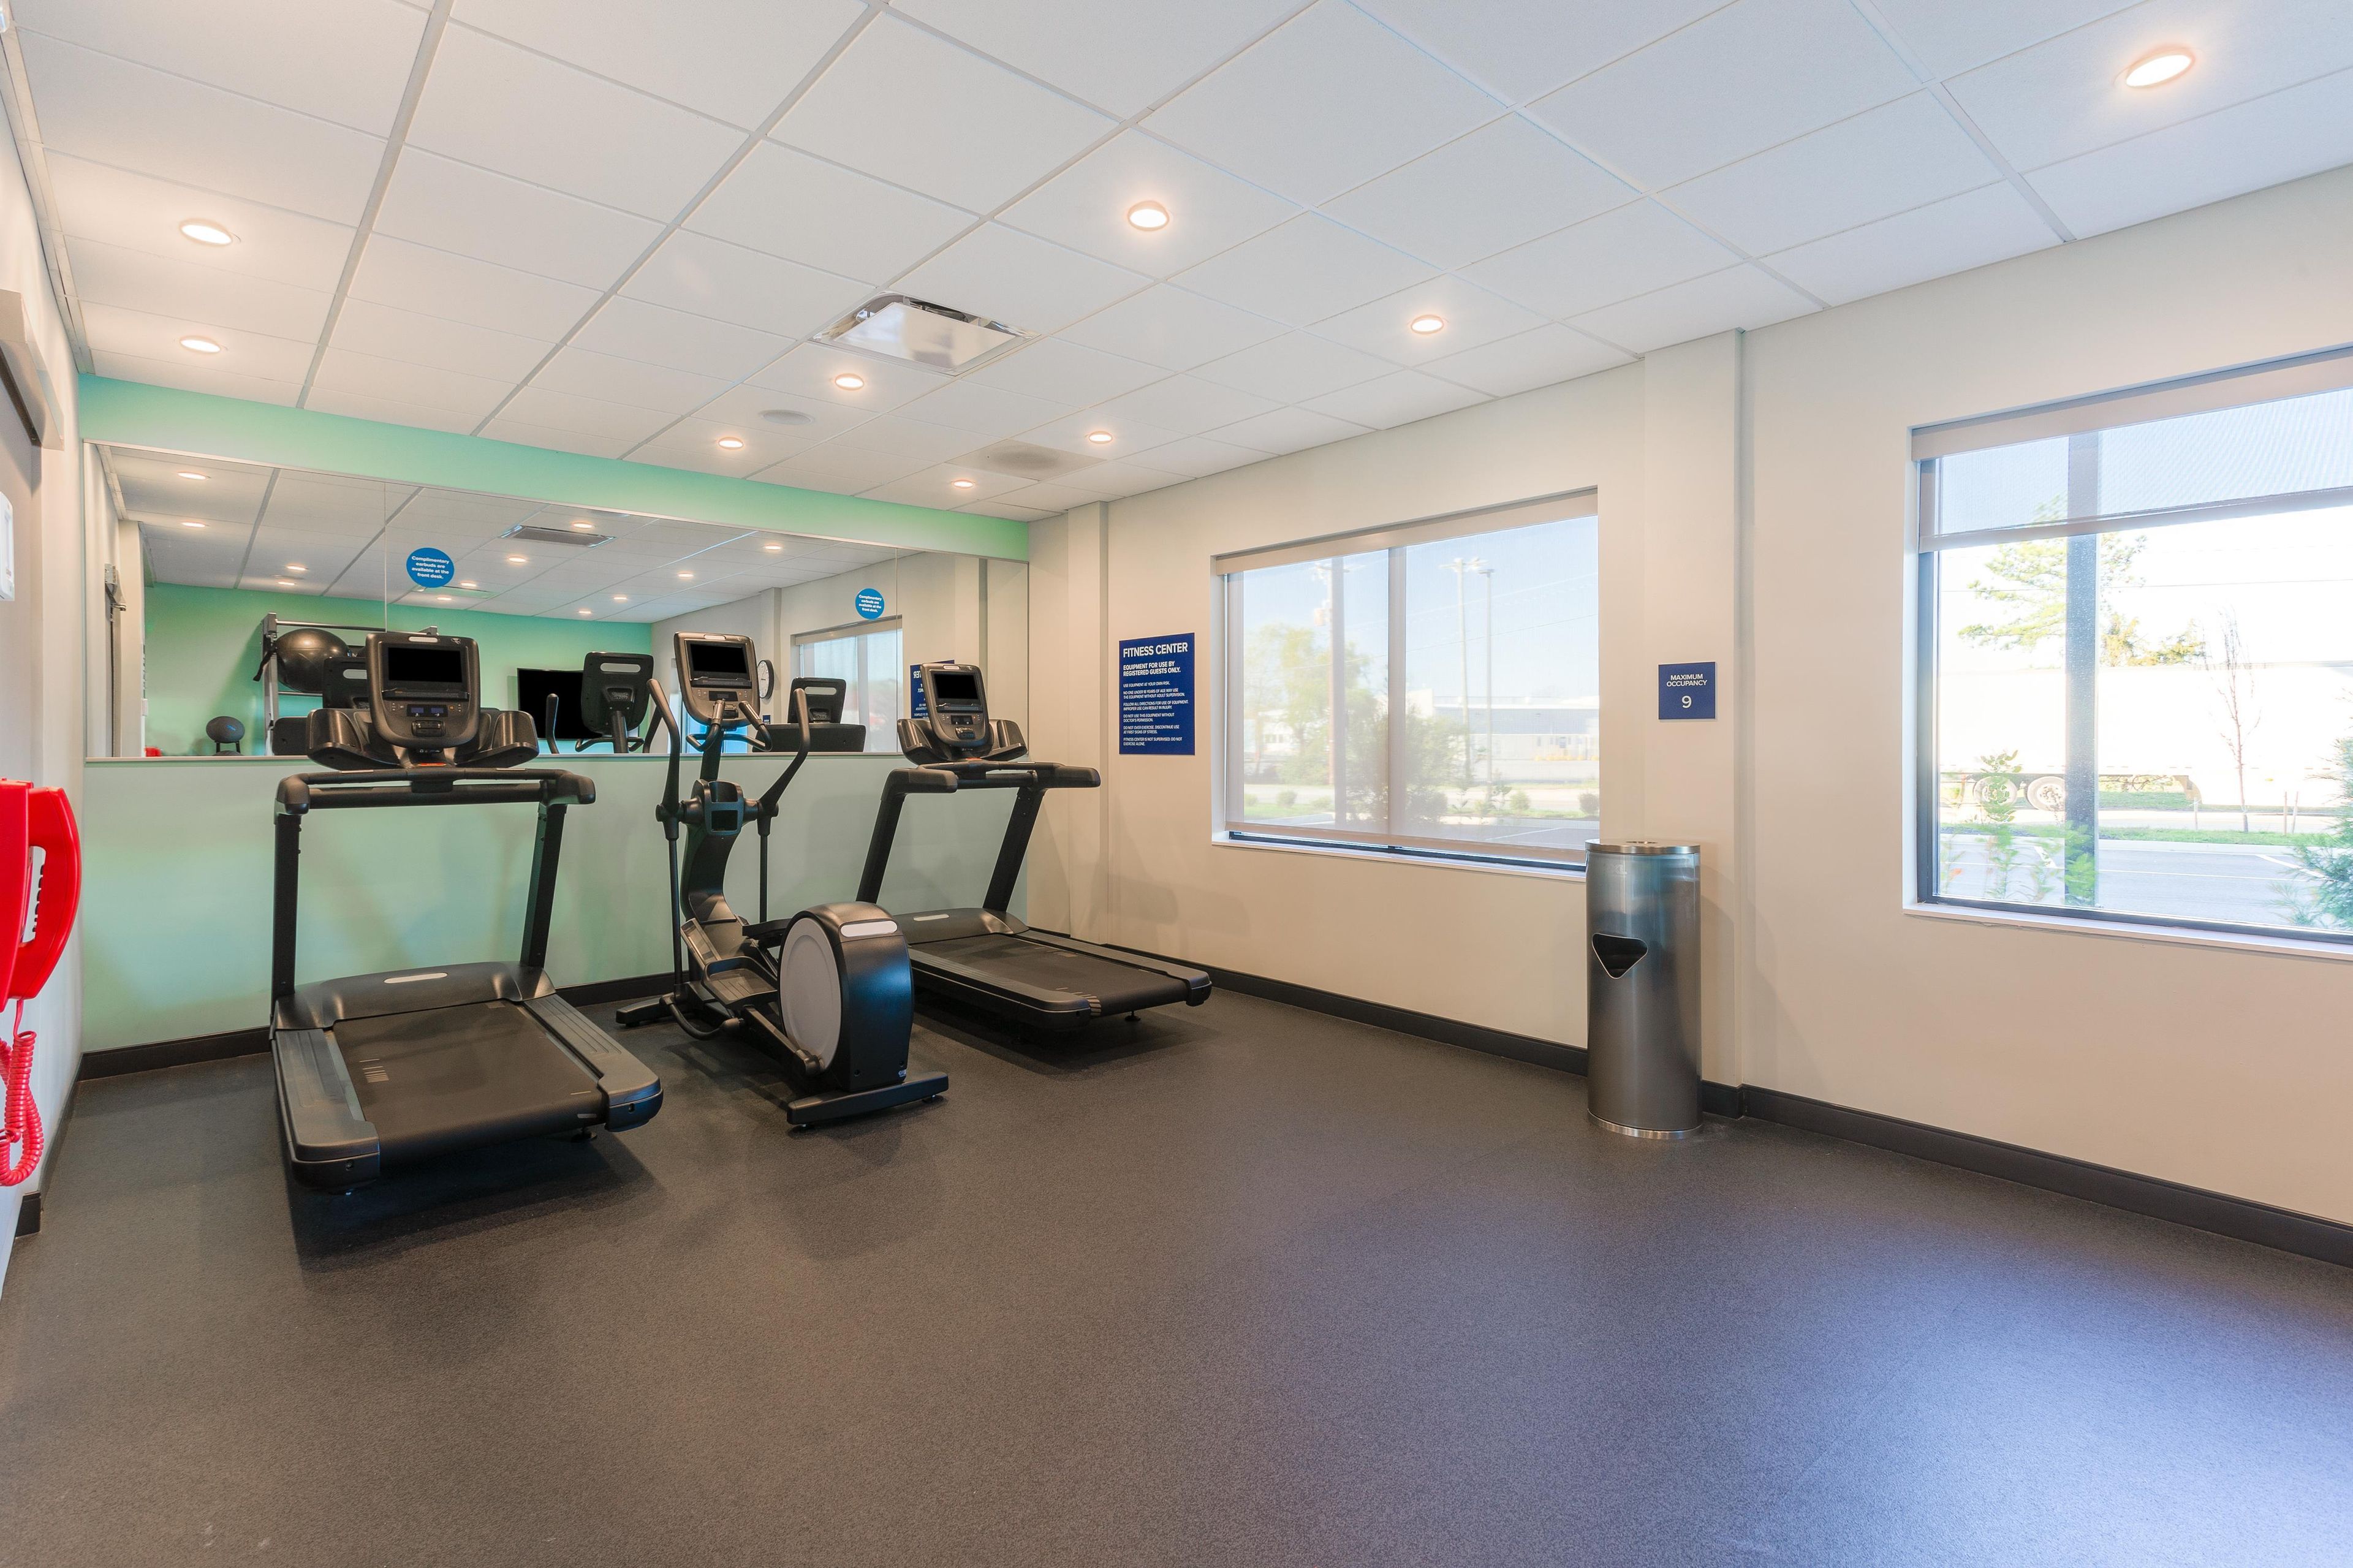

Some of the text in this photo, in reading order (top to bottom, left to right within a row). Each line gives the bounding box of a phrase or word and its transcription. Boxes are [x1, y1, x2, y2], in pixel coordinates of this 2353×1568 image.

[1123, 642, 1188, 657] FITNESS CENTER
[1682, 695, 1692, 708] 9
